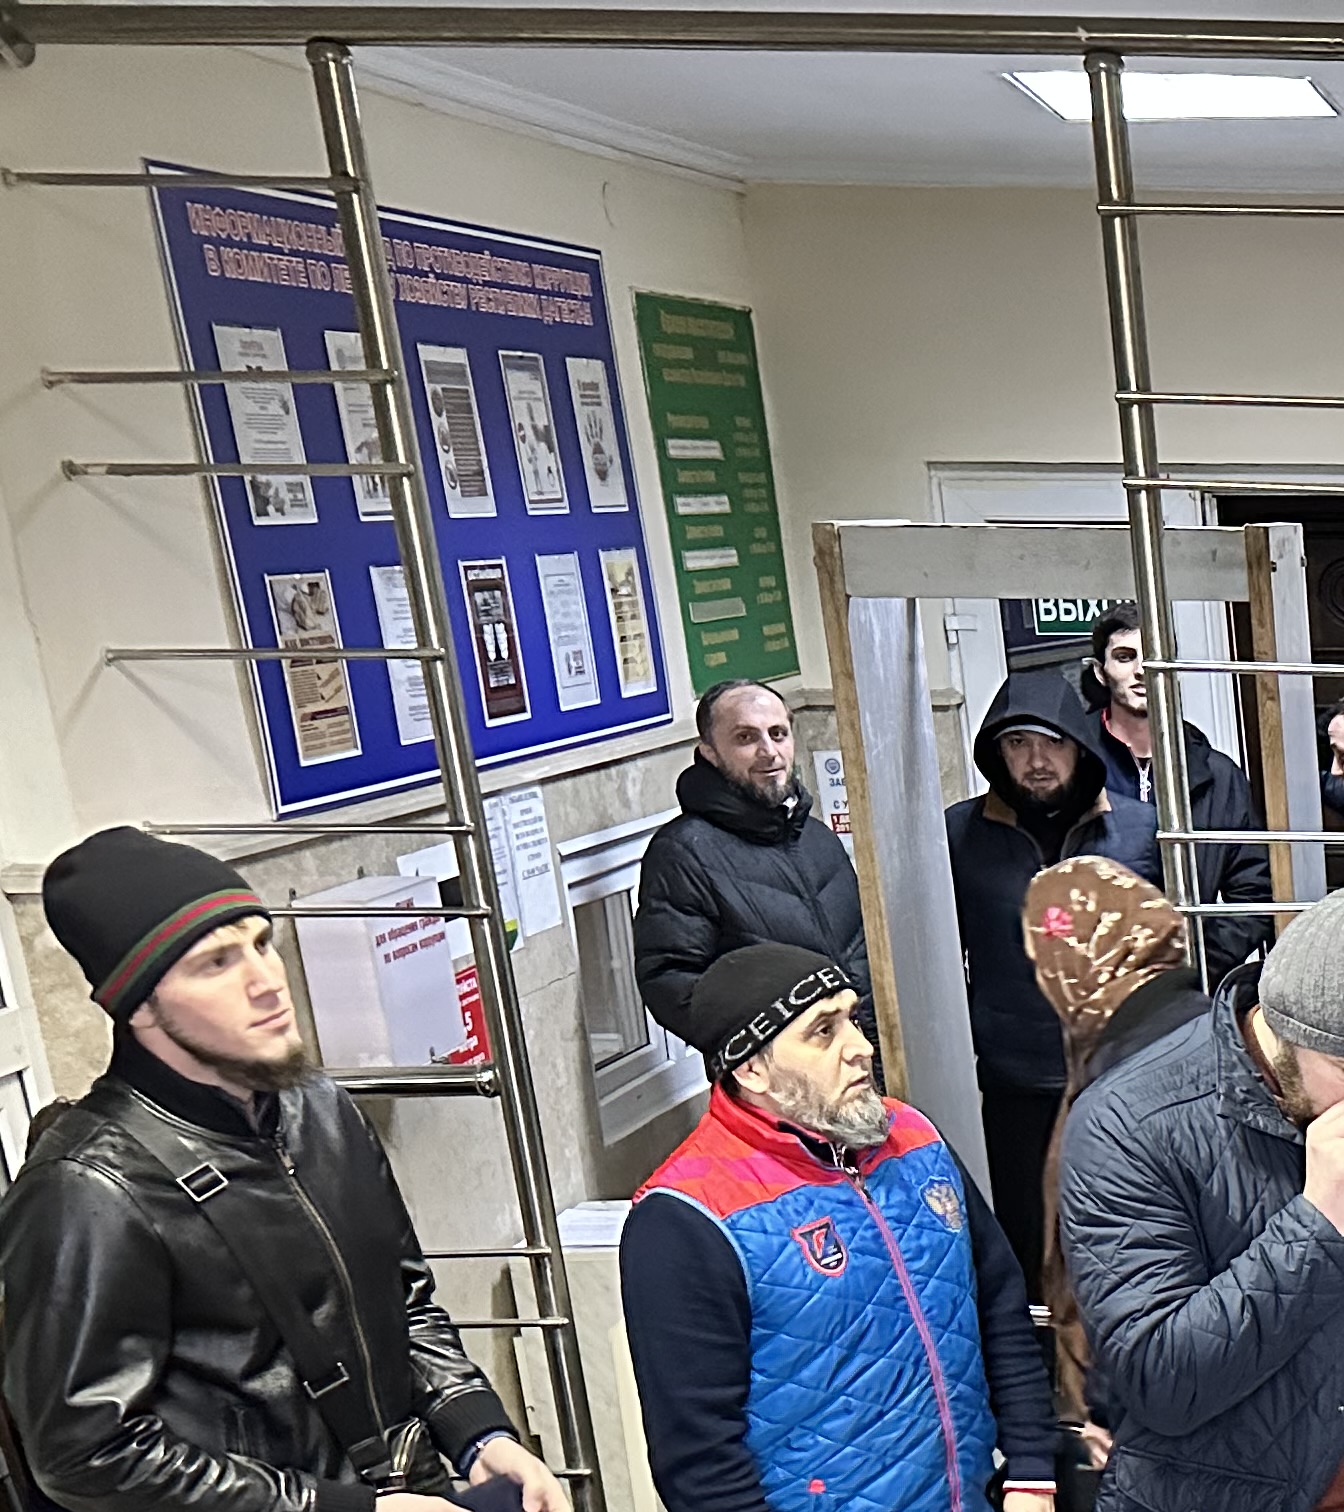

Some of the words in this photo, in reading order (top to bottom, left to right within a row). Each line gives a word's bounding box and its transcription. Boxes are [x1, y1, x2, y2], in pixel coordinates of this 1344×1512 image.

[203, 244, 221, 276] В
[220, 246, 309, 288] КОМИТЕТЕ
[306, 259, 332, 291] ПО
[540, 295, 594, 325] ДАГЕСТАН
[392, 238, 415, 268] ПО
[413, 242, 533, 287] ПРОТИВОДЕЙСТВИЮ
[531, 263, 593, 299] КОРРУПЦИИ
[1038, 598, 1138, 622] ВЫХ
